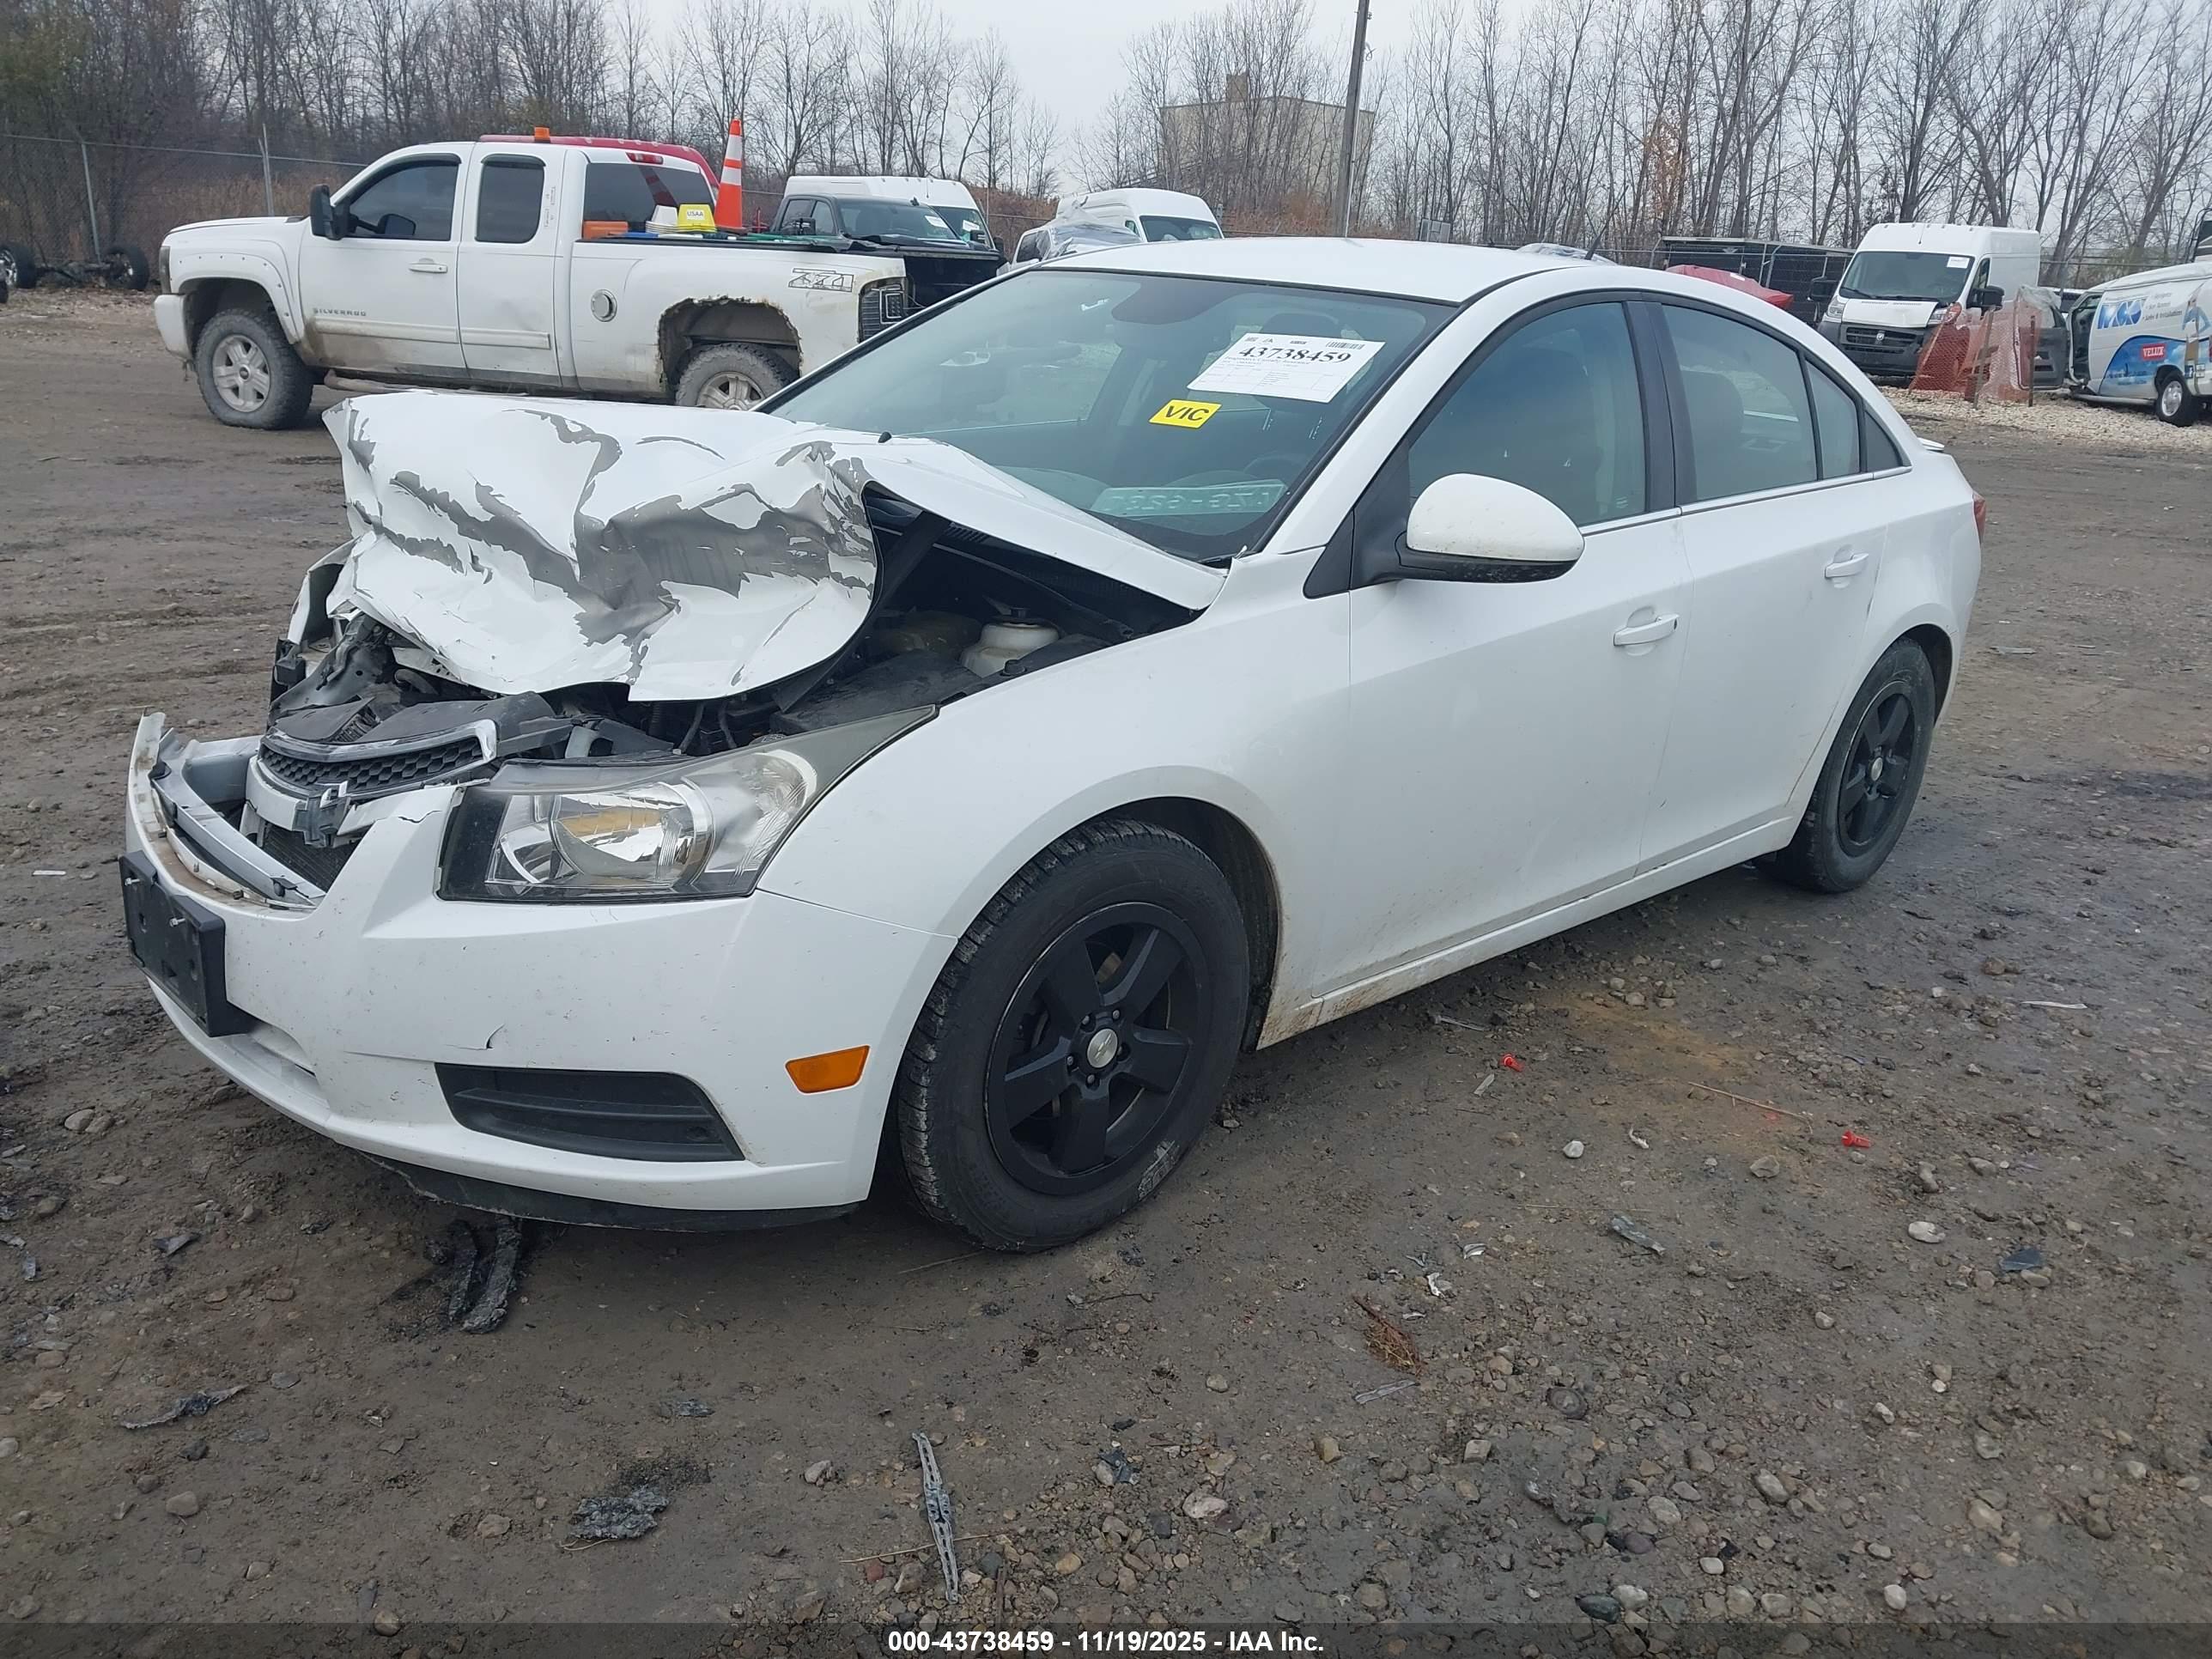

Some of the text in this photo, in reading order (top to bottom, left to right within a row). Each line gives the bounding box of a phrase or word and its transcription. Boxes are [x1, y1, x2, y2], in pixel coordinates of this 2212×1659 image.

[1239, 346, 1352, 363] 43738459
[2142, 346, 2165, 357] VELUX
[1166, 405, 1210, 421] VIC
